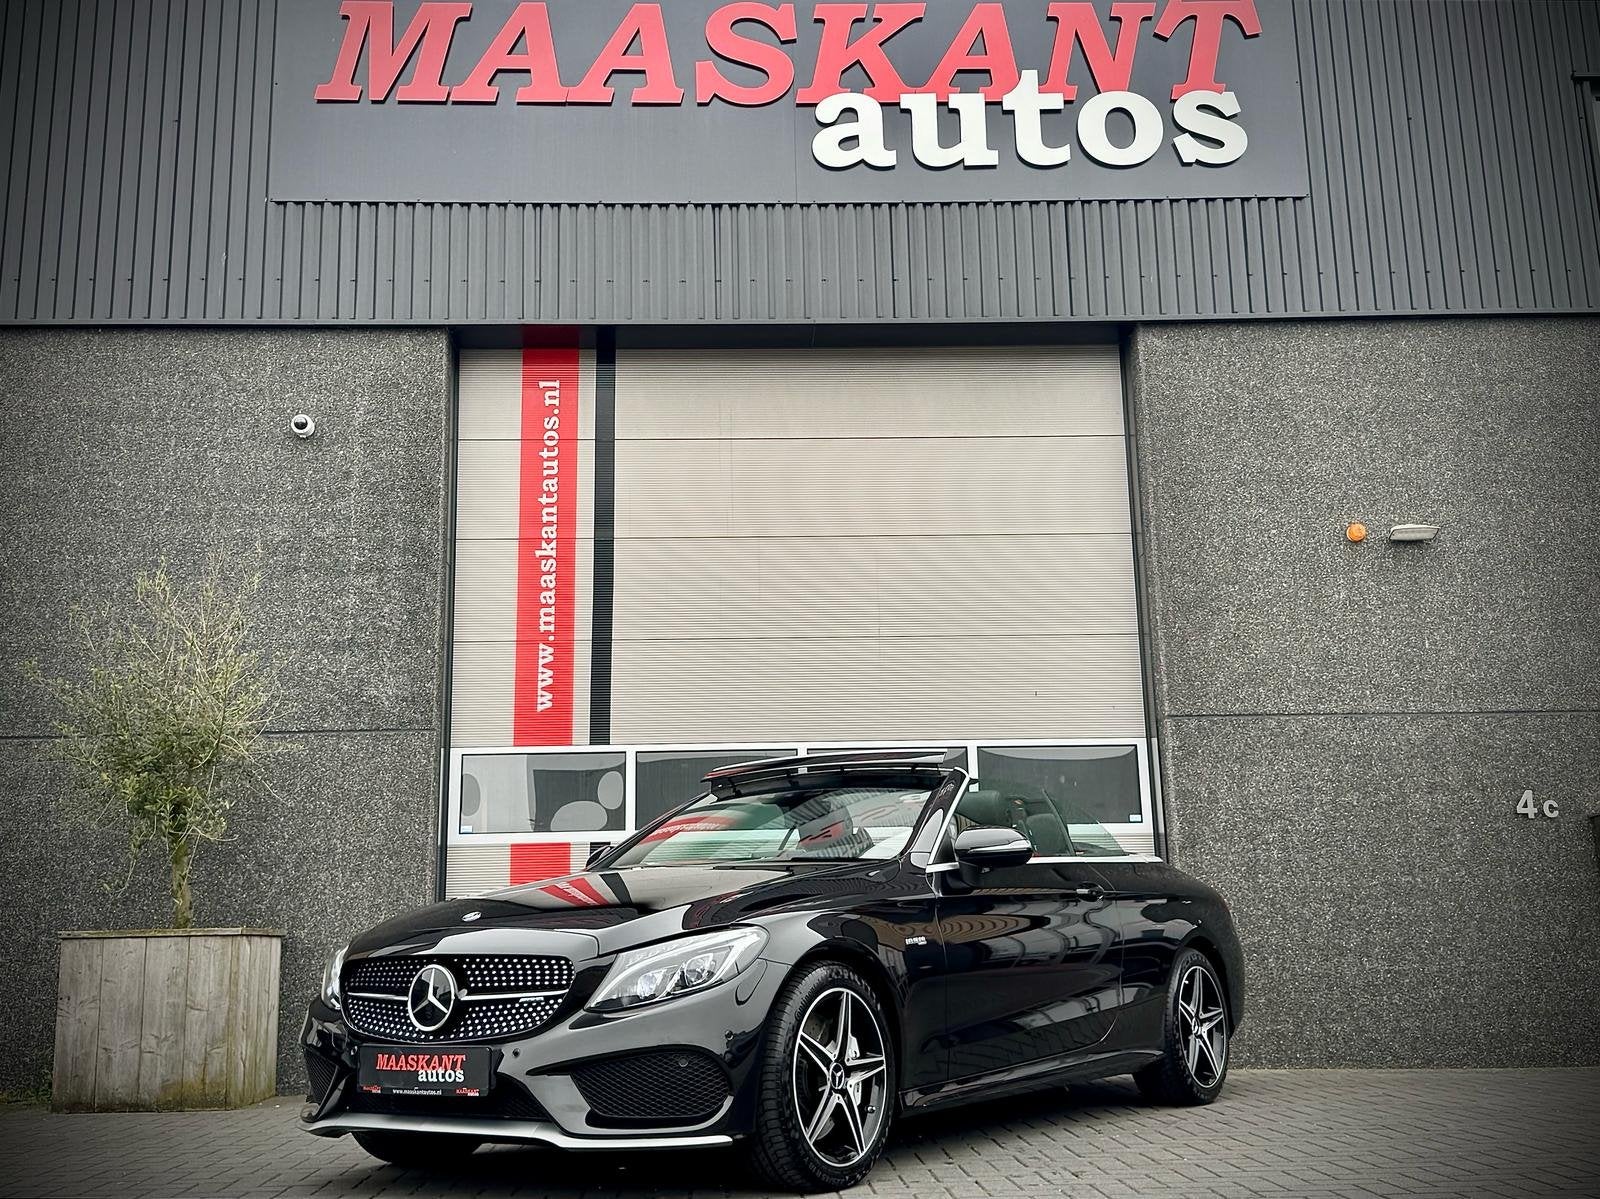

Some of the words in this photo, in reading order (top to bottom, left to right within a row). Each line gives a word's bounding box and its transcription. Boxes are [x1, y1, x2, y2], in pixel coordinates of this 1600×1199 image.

[316, 1, 1262, 106] MAASKANT
[812, 69, 1249, 169] autos
[535, 379, 561, 713] www.maaskantautos.nl
[376, 1053, 466, 1071] MAASKANT
[418, 1067, 465, 1082] autos
